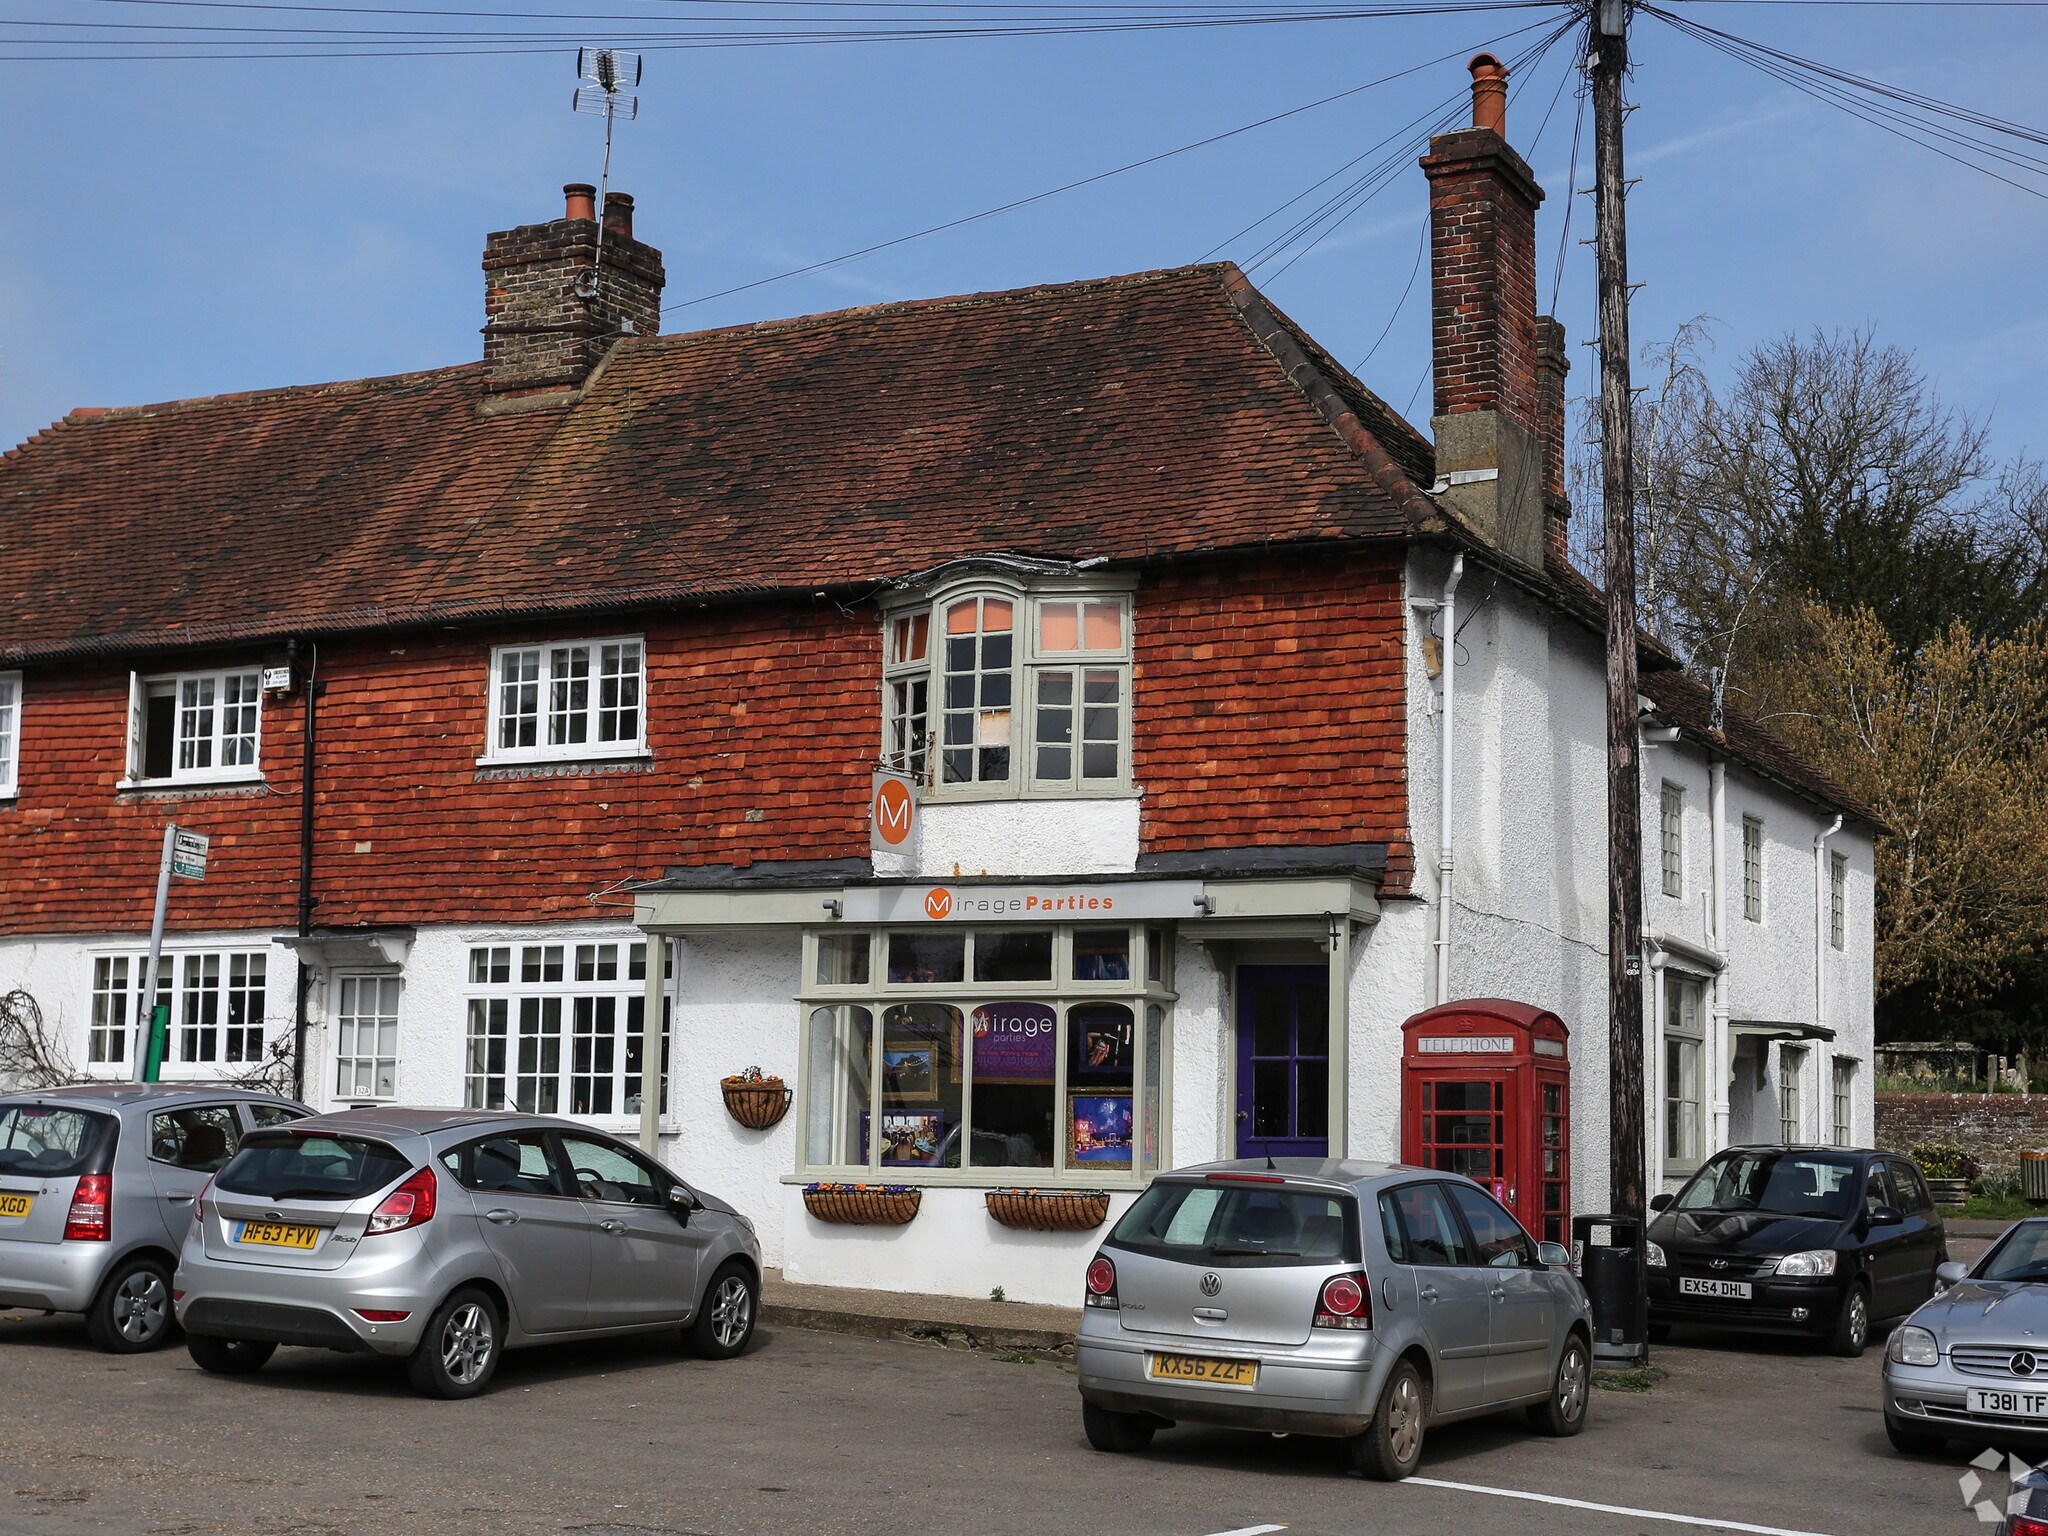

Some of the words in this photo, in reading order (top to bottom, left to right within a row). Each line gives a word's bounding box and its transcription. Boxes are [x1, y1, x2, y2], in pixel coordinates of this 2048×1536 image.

[879, 793, 909, 830] M
[926, 895, 1021, 914] Mirage
[1026, 895, 1114, 911] Parties
[993, 1033, 1027, 1043] parties
[1421, 1038, 1510, 1051] TELEPHONE
[243, 1223, 282, 1242] HF63
[284, 1226, 317, 1245] FYV
[1684, 1280, 1718, 1294] EX54
[1721, 1283, 1747, 1297] DHL
[1120, 1302, 1146, 1311] POLO
[1159, 1355, 1206, 1376] KX56
[1210, 1360, 1249, 1380] ZZF
[1977, 1391, 2018, 1412] T381
